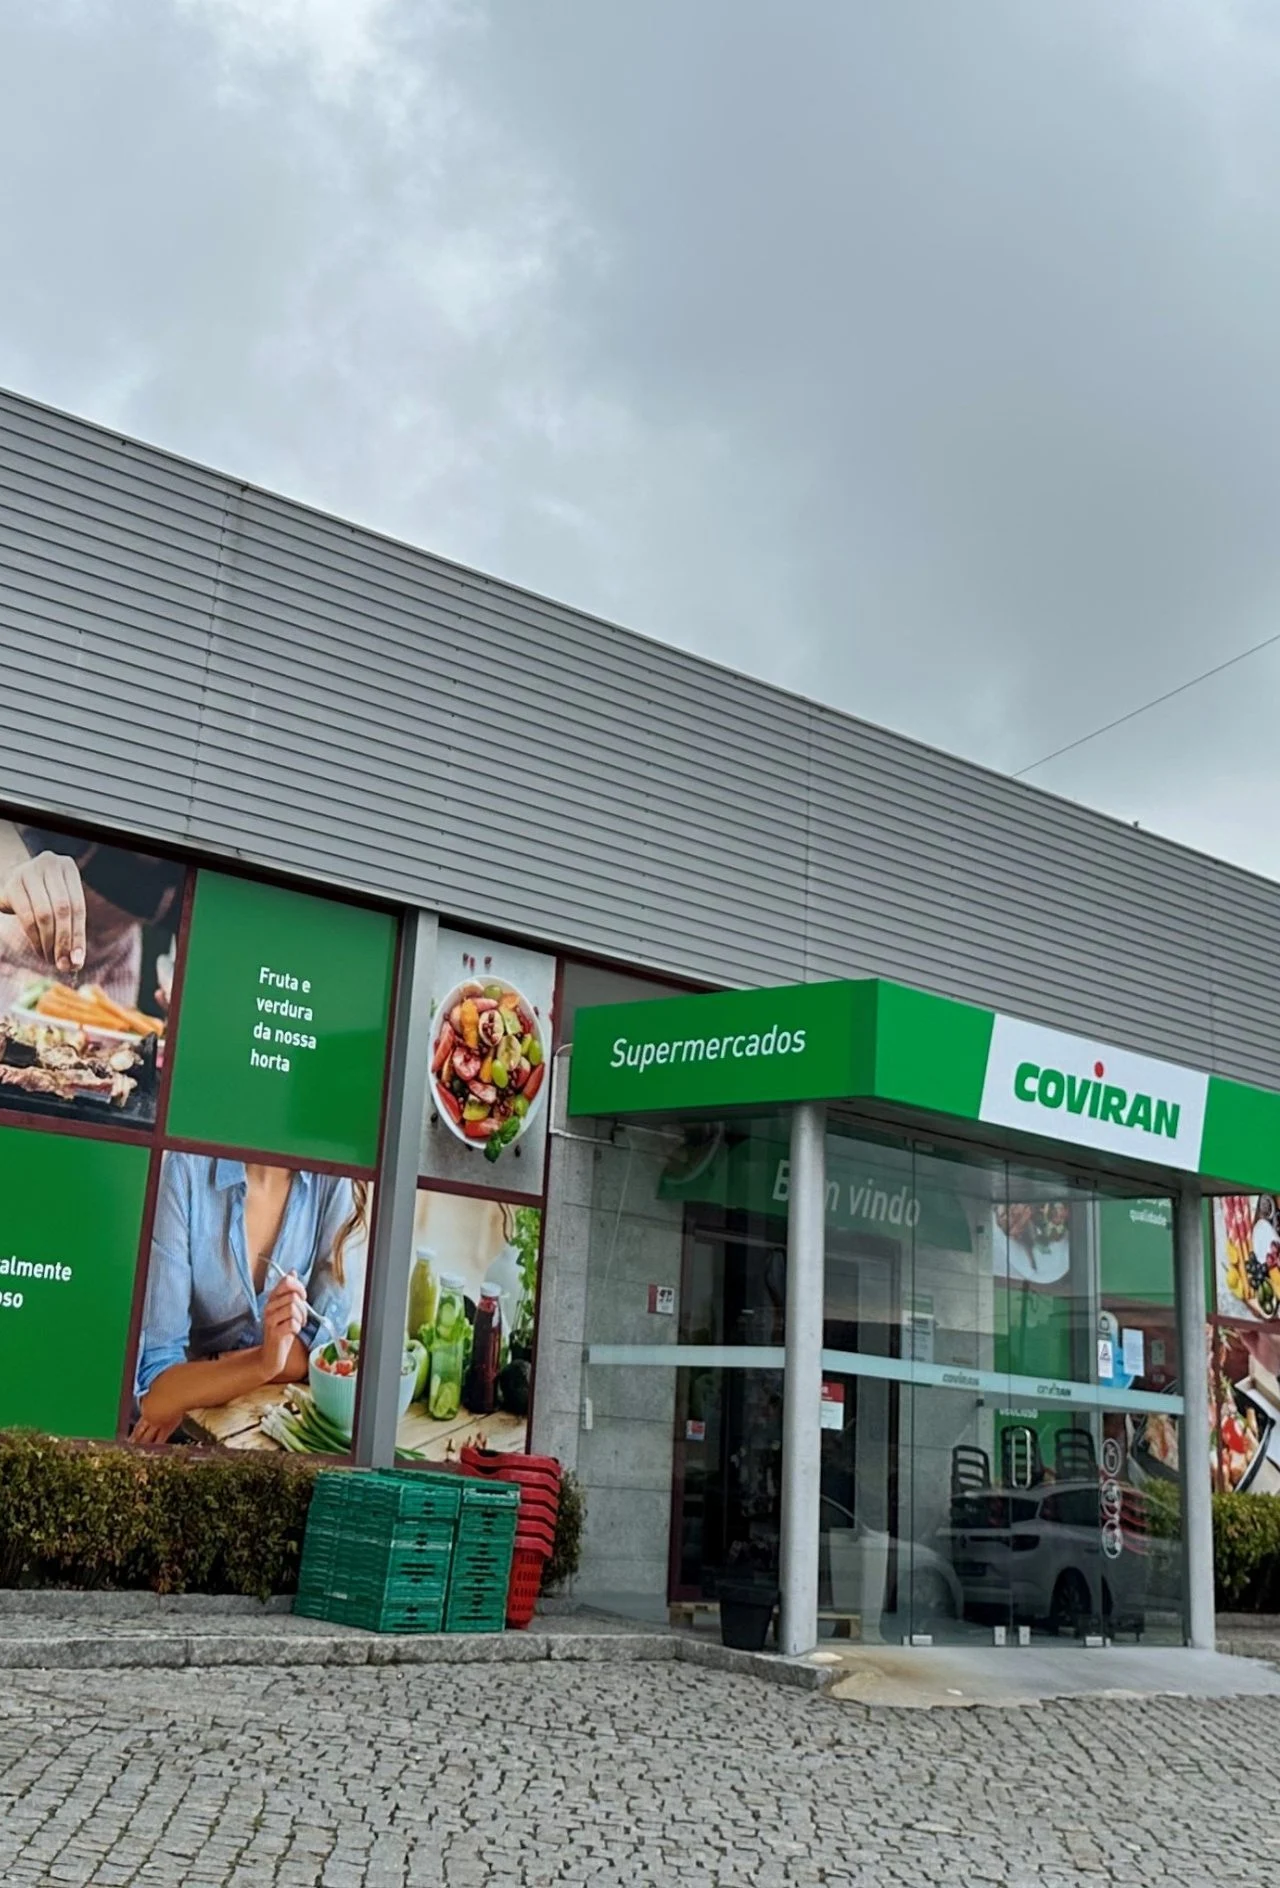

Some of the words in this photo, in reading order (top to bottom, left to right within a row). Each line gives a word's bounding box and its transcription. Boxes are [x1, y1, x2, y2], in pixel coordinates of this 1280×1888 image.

[259, 966, 299, 991] Fruta
[301, 980, 312, 993] e
[256, 997, 313, 1021] verdura
[253, 1021, 272, 1041] da
[274, 1029, 317, 1050] nossa
[610, 1024, 806, 1073] Supermercados
[250, 1048, 290, 1072] horta
[849, 1178, 922, 1227] vindo
